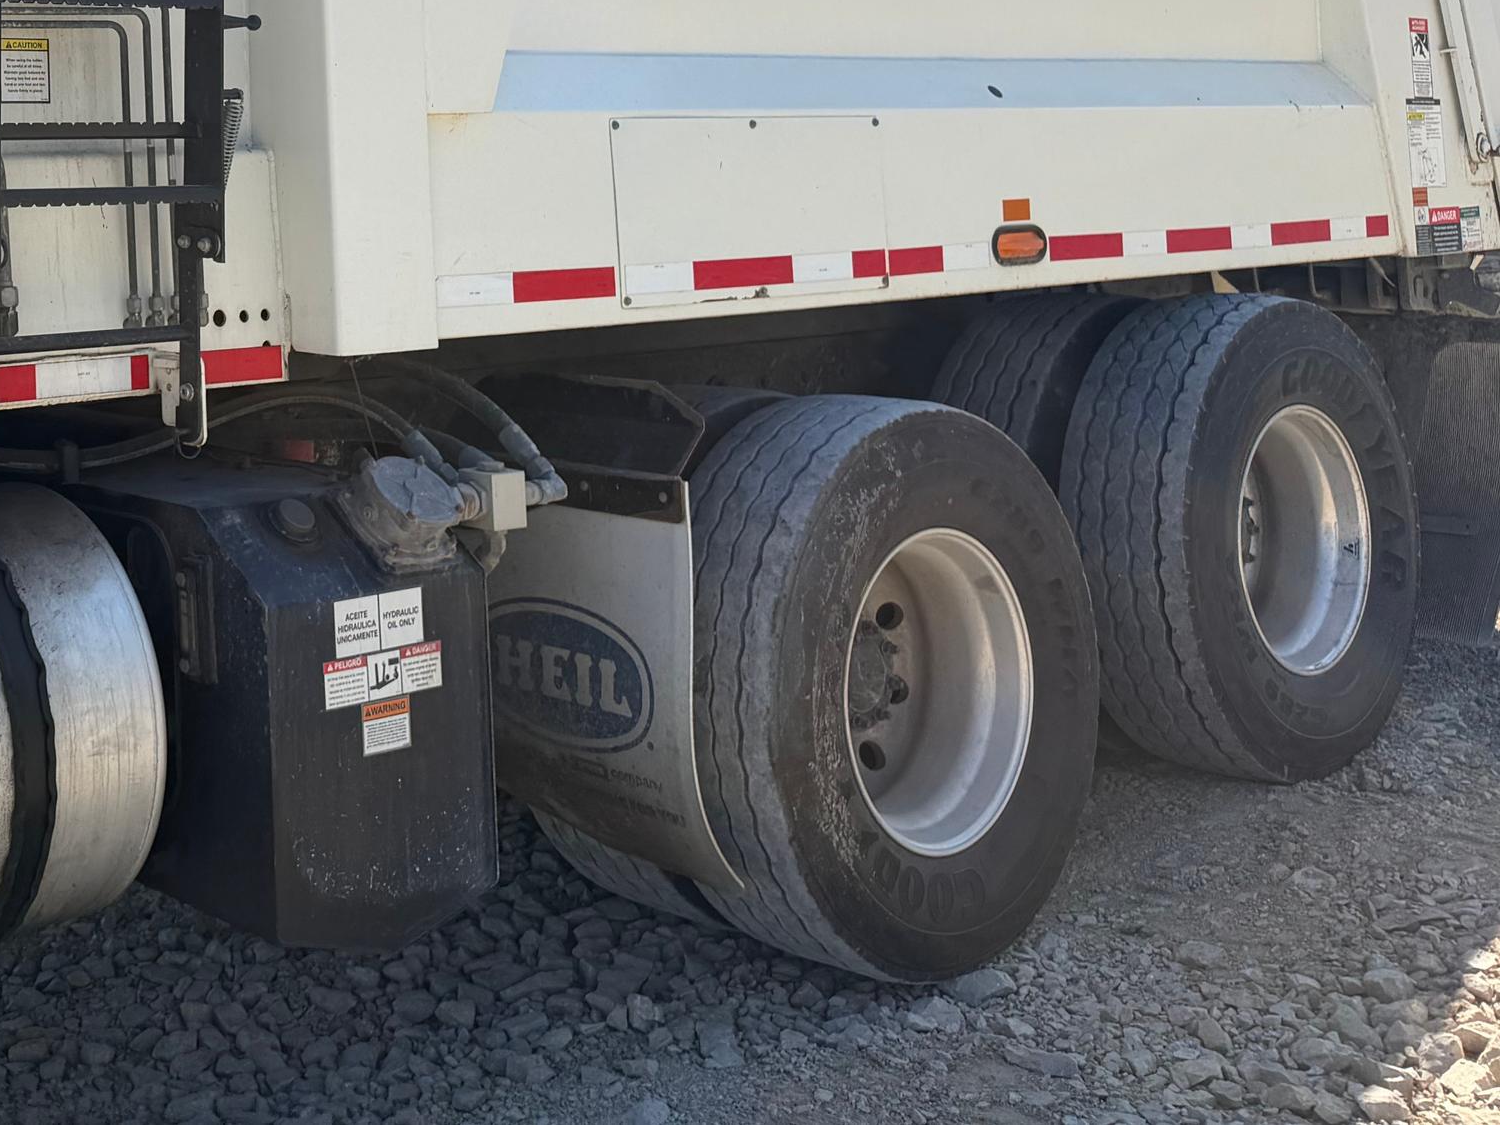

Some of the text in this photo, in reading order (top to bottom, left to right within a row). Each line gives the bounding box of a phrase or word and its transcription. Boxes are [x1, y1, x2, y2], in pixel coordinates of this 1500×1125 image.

[1436, 210, 1457, 221] DANGER
[345, 610, 368, 621] ACEITE
[382, 606, 419, 619] HYDRAULIC
[337, 620, 377, 634] HIDRAULICA
[387, 617, 416, 629] OIL ONLY
[336, 629, 379, 645] UNICAMENTE
[411, 644, 438, 656] DANGER
[334, 658, 362, 670] PELIGRO
[495, 634, 633, 718] HEIL
[370, 701, 406, 715] WARNING
